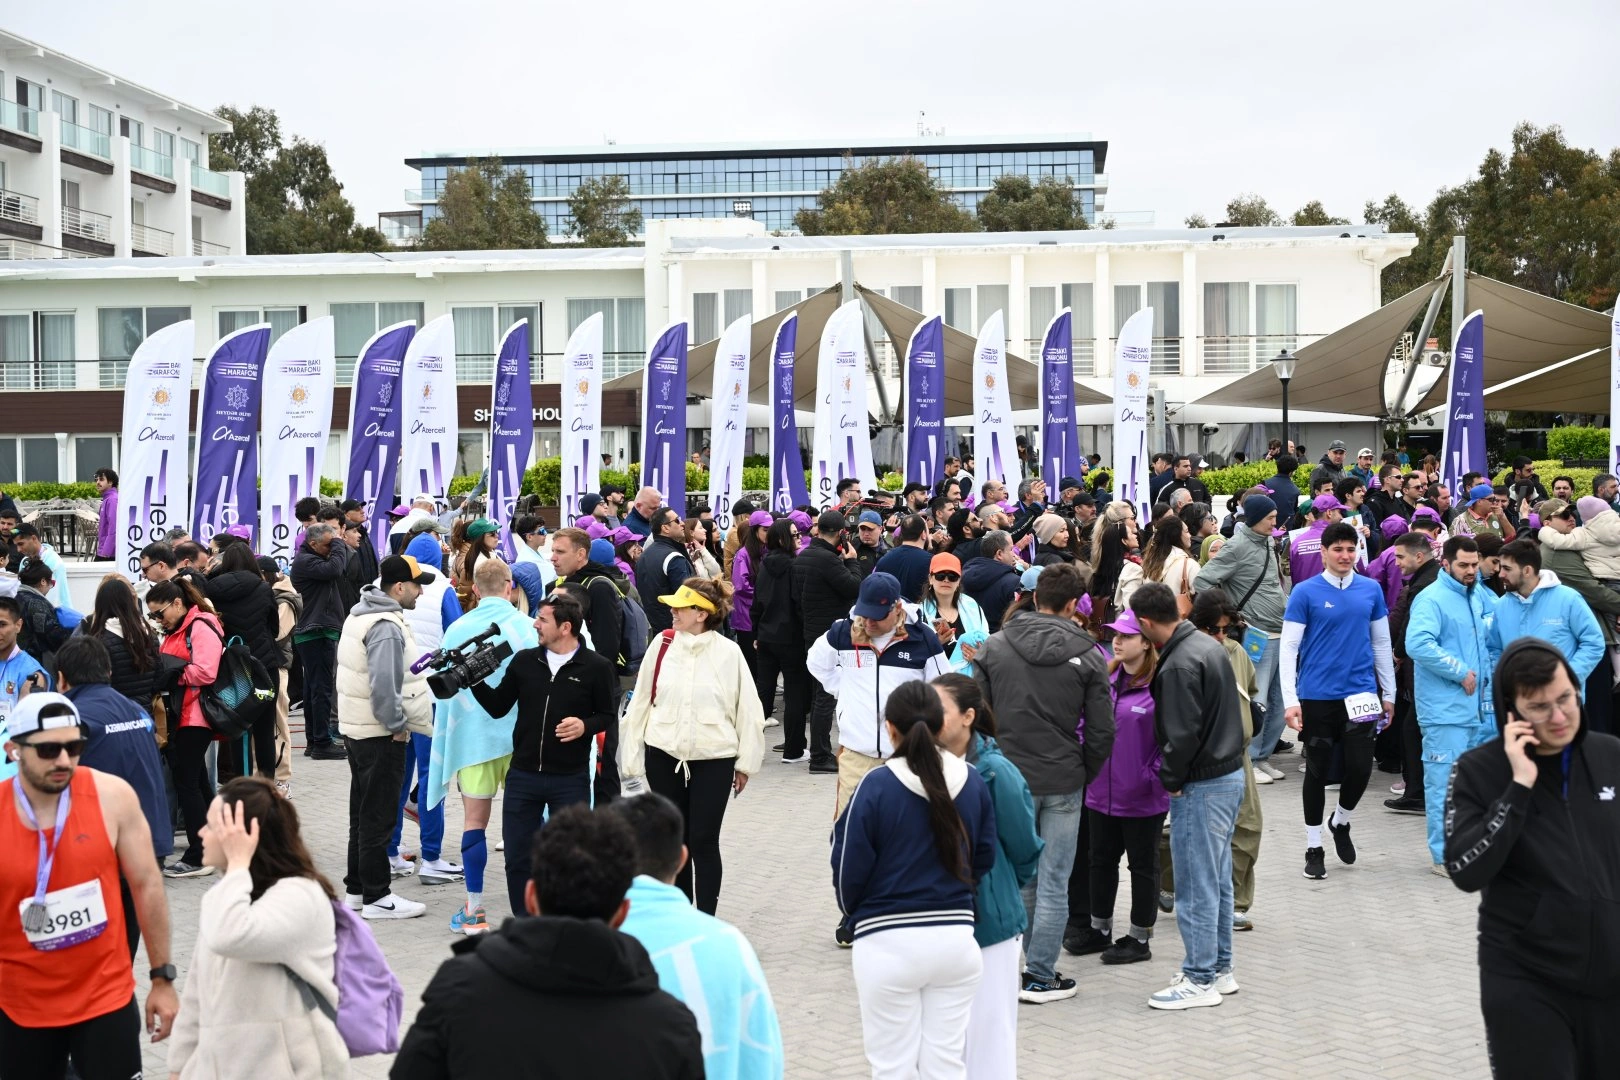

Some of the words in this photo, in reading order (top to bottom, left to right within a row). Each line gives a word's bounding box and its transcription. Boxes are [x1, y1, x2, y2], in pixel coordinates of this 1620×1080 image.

[474, 408, 492, 421] SH
[532, 408, 562, 421] HOU
[150, 495, 166, 543] GƏL
[128, 524, 143, 584] ƏYƏ
[1352, 703, 1379, 715] 17048
